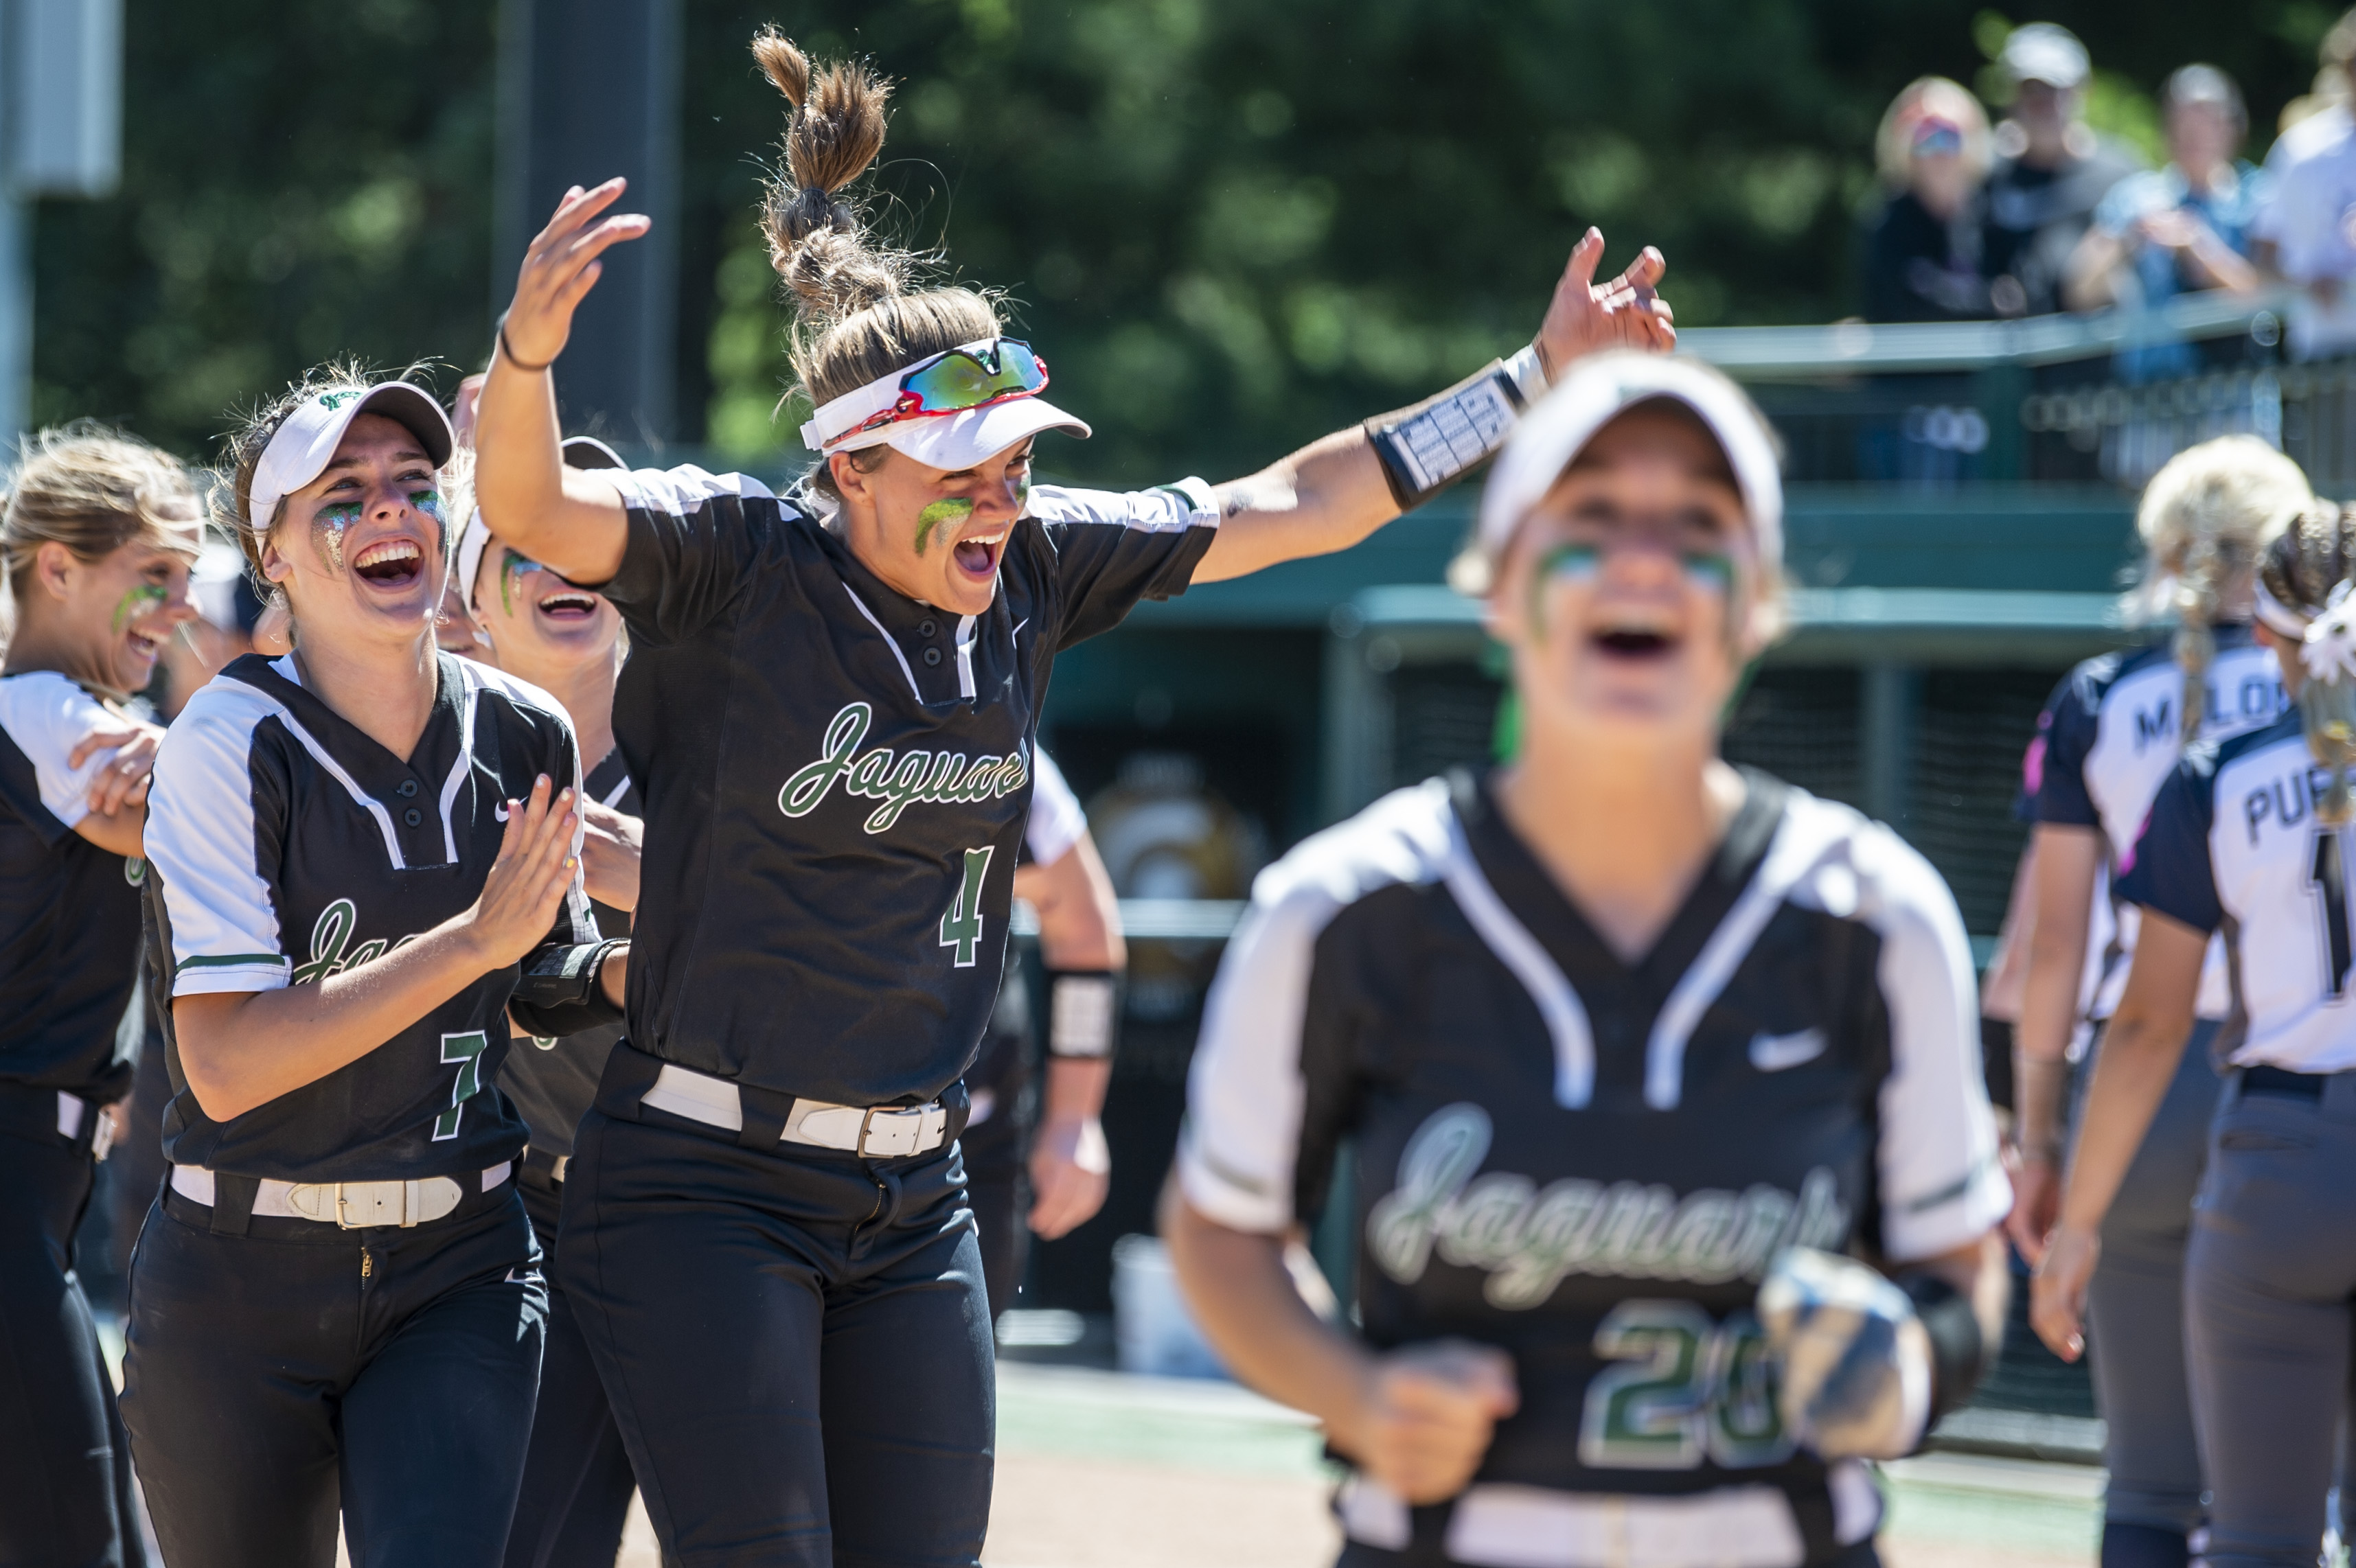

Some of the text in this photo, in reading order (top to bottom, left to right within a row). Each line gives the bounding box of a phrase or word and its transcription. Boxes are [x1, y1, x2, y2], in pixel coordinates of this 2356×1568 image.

[2134, 678, 2294, 752] MLO
[939, 845, 995, 968] 4
[431, 1030, 487, 1142] 7
[1578, 1299, 1800, 1469] 20
